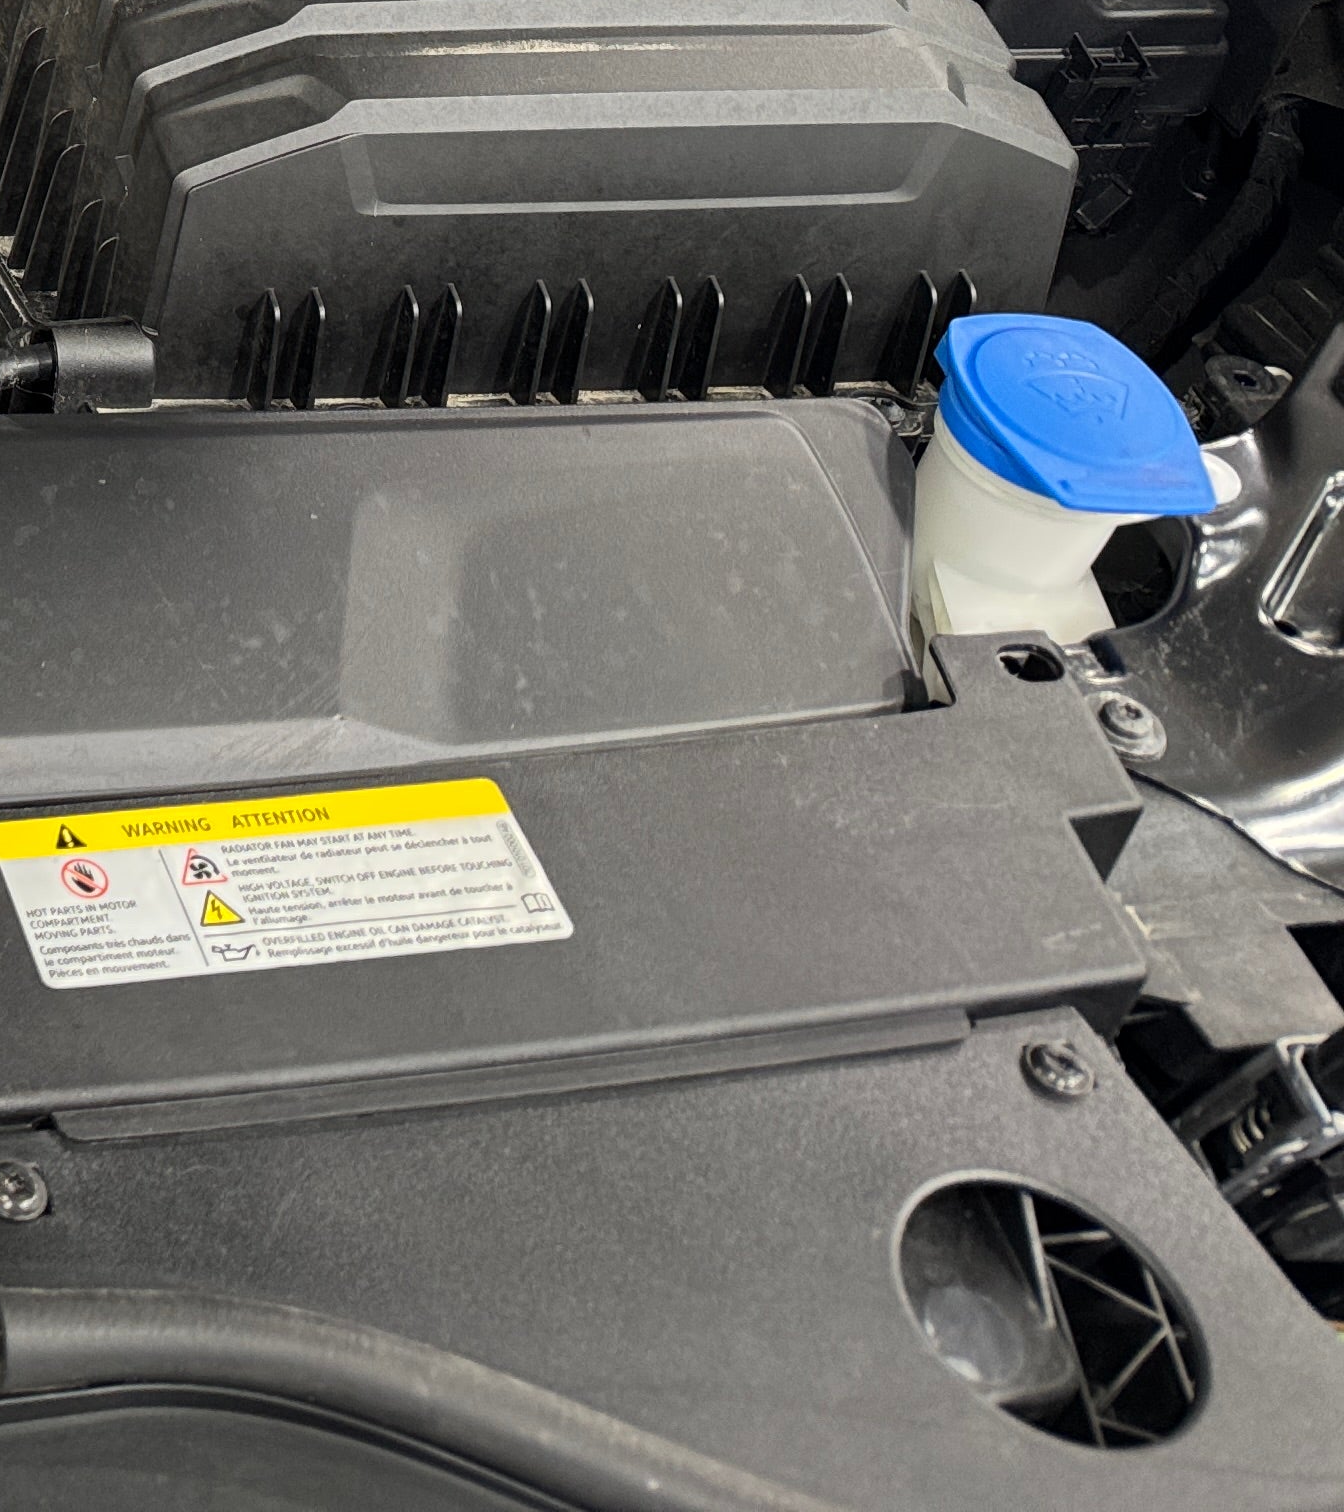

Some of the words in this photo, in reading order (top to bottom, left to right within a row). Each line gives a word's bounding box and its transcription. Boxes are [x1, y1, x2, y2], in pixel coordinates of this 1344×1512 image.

[121, 817, 211, 838] WARNING
[232, 807, 330, 829] ATTENTION
[220, 840, 272, 854] RADIATOR
[274, 839, 295, 850] FAN
[297, 837, 318, 847] MAY
[319, 834, 350, 846] START
[353, 832, 364, 841] AT
[367, 829, 387, 840] ANY
[226, 857, 239, 867] Le
[241, 853, 297, 866] ventilateur
[300, 850, 313, 860] de
[315, 847, 362, 859] radiateur
[365, 843, 389, 855] peut
[391, 842, 402, 851] se
[471, 834, 492, 844] tout
[238, 882, 264, 892] HIGH
[315, 874, 355, 886] SWITCH
[356, 871, 376, 881] OFF
[379, 867, 417, 879] ENGINE
[419, 863, 457, 875] BEFORE
[460, 859, 513, 872] TOUCHING
[26, 908, 47, 918] HOT
[50, 904, 83, 915] PARTS
[85, 903, 97, 912] IN
[99, 900, 137, 911] MOTOR
[242, 890, 290, 903] IGNITION
[248, 905, 281, 915] Haute
[364, 895, 375, 904] le
[377, 892, 415, 903] moteur
[418, 888, 446, 899] avant
[449, 886, 463, 896] de
[464, 883, 504, 894] toucher
[34, 929, 78, 941] MOVING
[39, 941, 104, 956] Composants
[128, 935, 163, 947] chauds
[165, 933, 191, 943] dans
[262, 933, 325, 947] OVERFILLED
[327, 928, 368, 940] ENGINE
[369, 925, 386, 935] OIL
[388, 923, 410, 934] CAN
[412, 919, 454, 932] DAMAGE
[267, 945, 333, 959] Remplissage
[335, 938, 376, 952] excessif
[416, 931, 470, 944] dangereux
[472, 928, 496, 940] pour
[44, 957, 55, 966] le
[57, 951, 134, 966] compartiment
[86, 966, 99, 976] en
